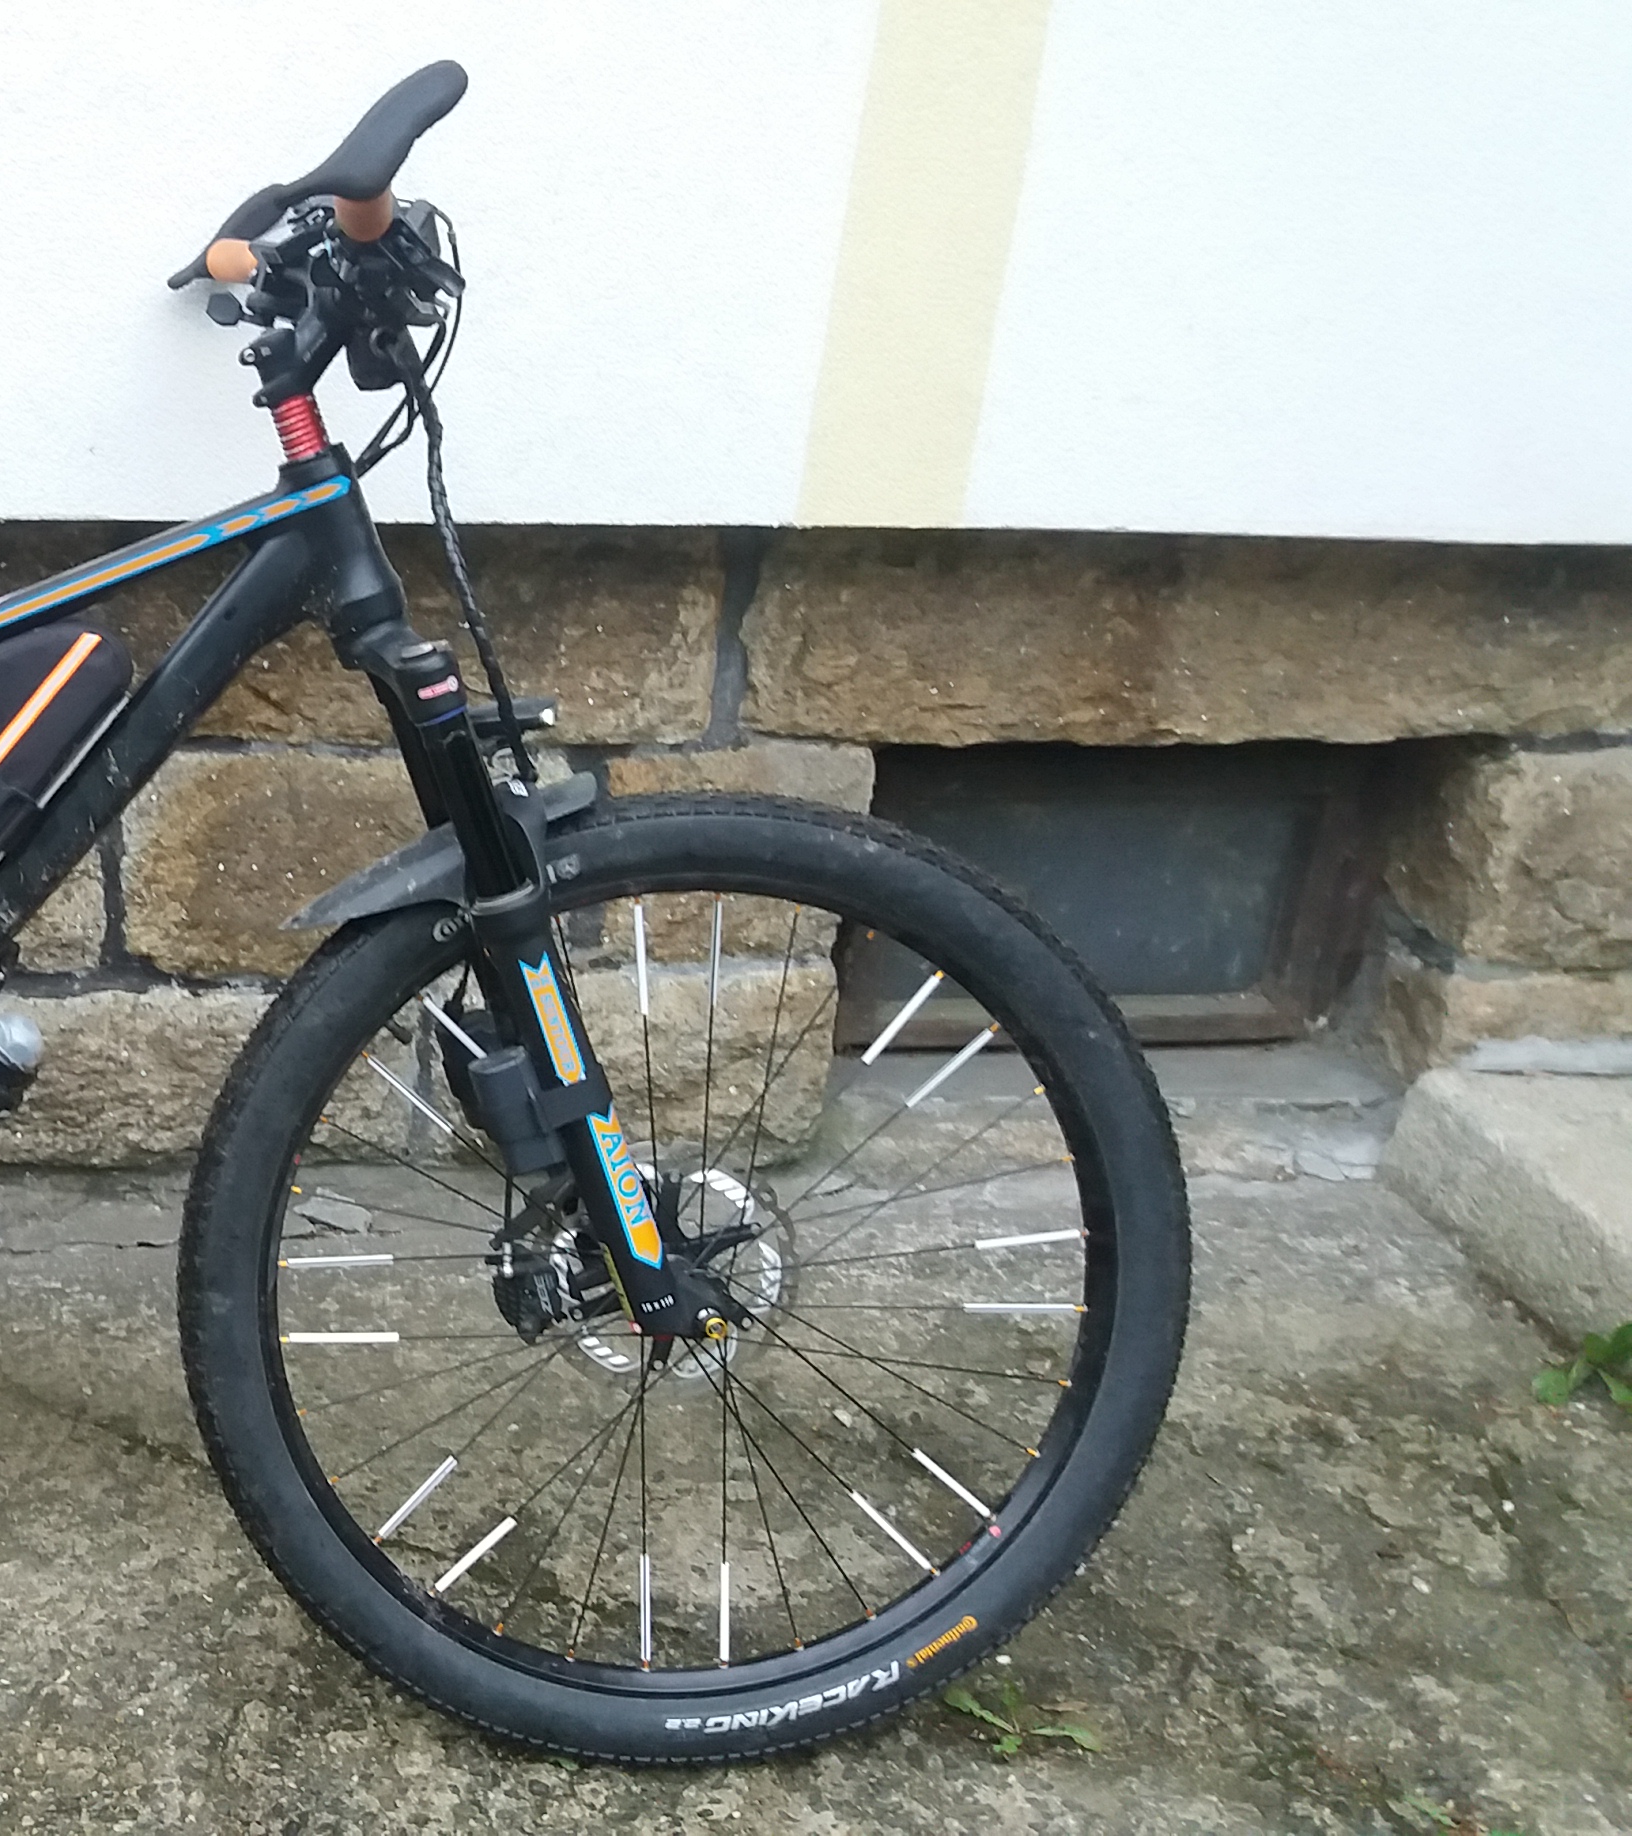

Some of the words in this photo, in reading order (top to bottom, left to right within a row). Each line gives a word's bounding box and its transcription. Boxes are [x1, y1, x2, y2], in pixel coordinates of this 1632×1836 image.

[540, 993, 575, 1073] SUNTOUR
[600, 1131, 652, 1227] AION
[915, 1615, 979, 1664] Continental
